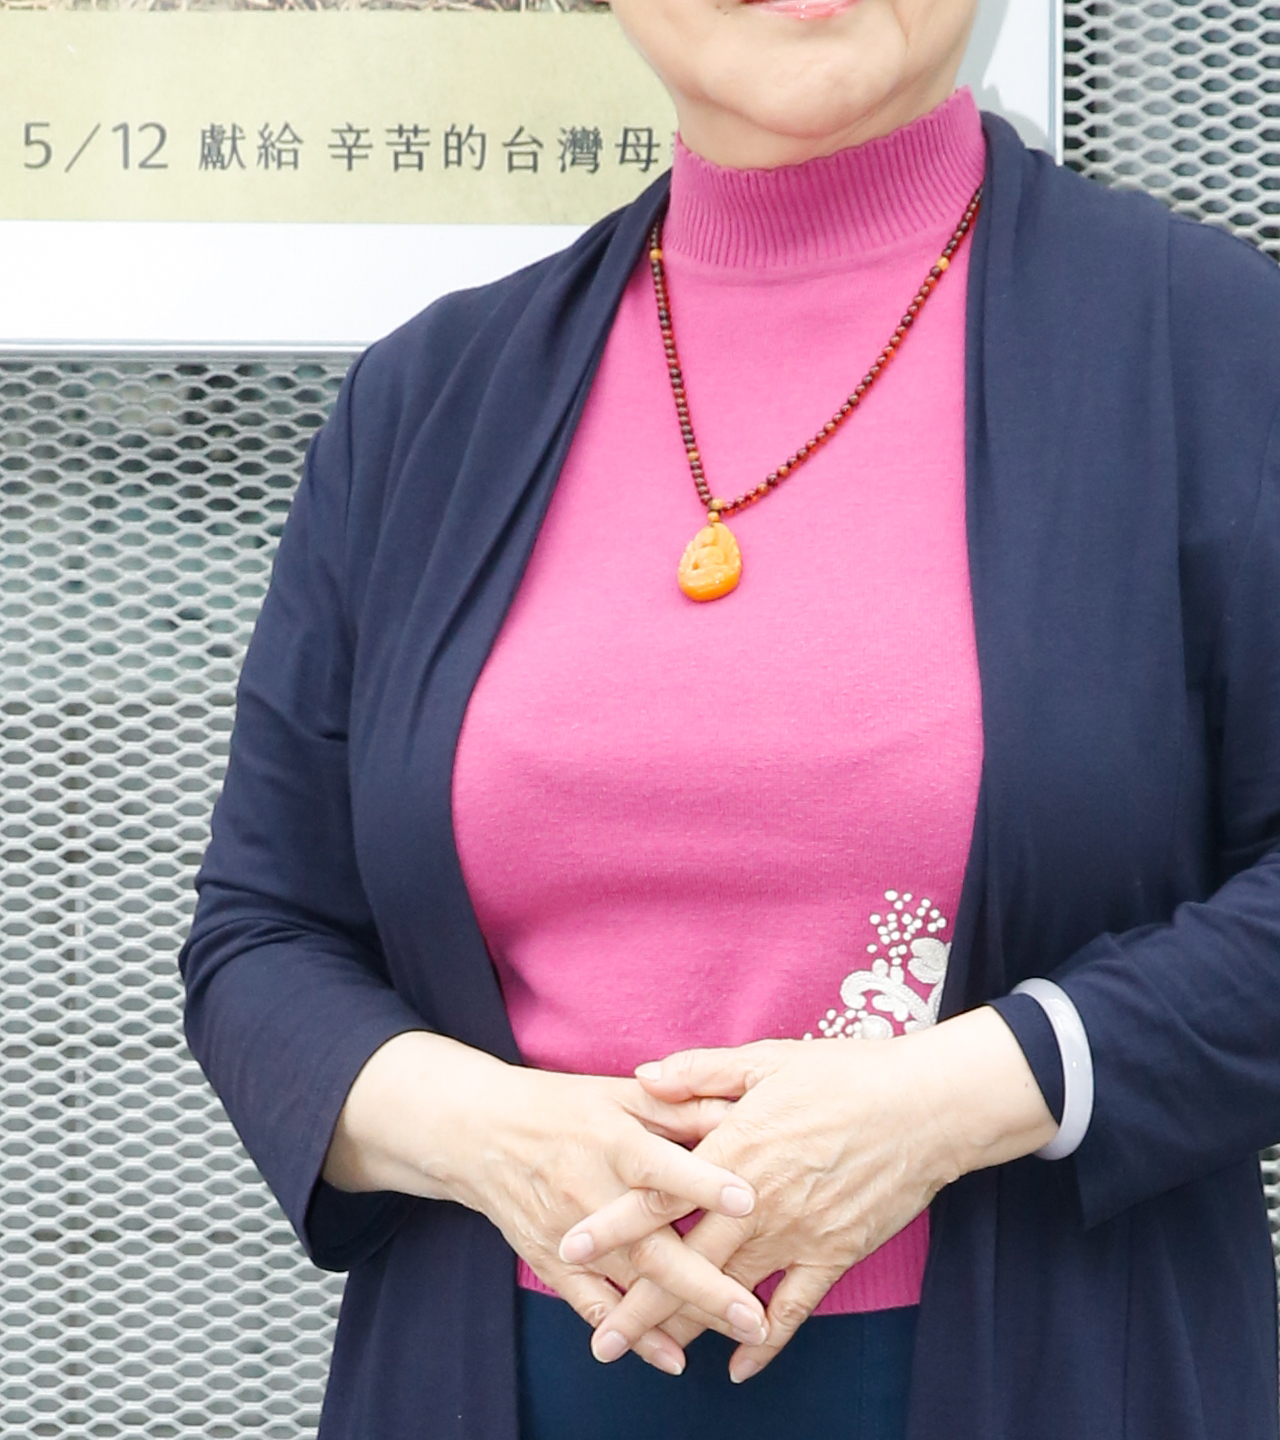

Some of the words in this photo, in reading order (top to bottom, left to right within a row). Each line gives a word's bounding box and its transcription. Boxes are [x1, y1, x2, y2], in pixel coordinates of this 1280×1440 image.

[22, 121, 170, 174] 5/12
[198, 122, 305, 171] 獻給
[327, 123, 675, 174] 辛苦的台灣母
